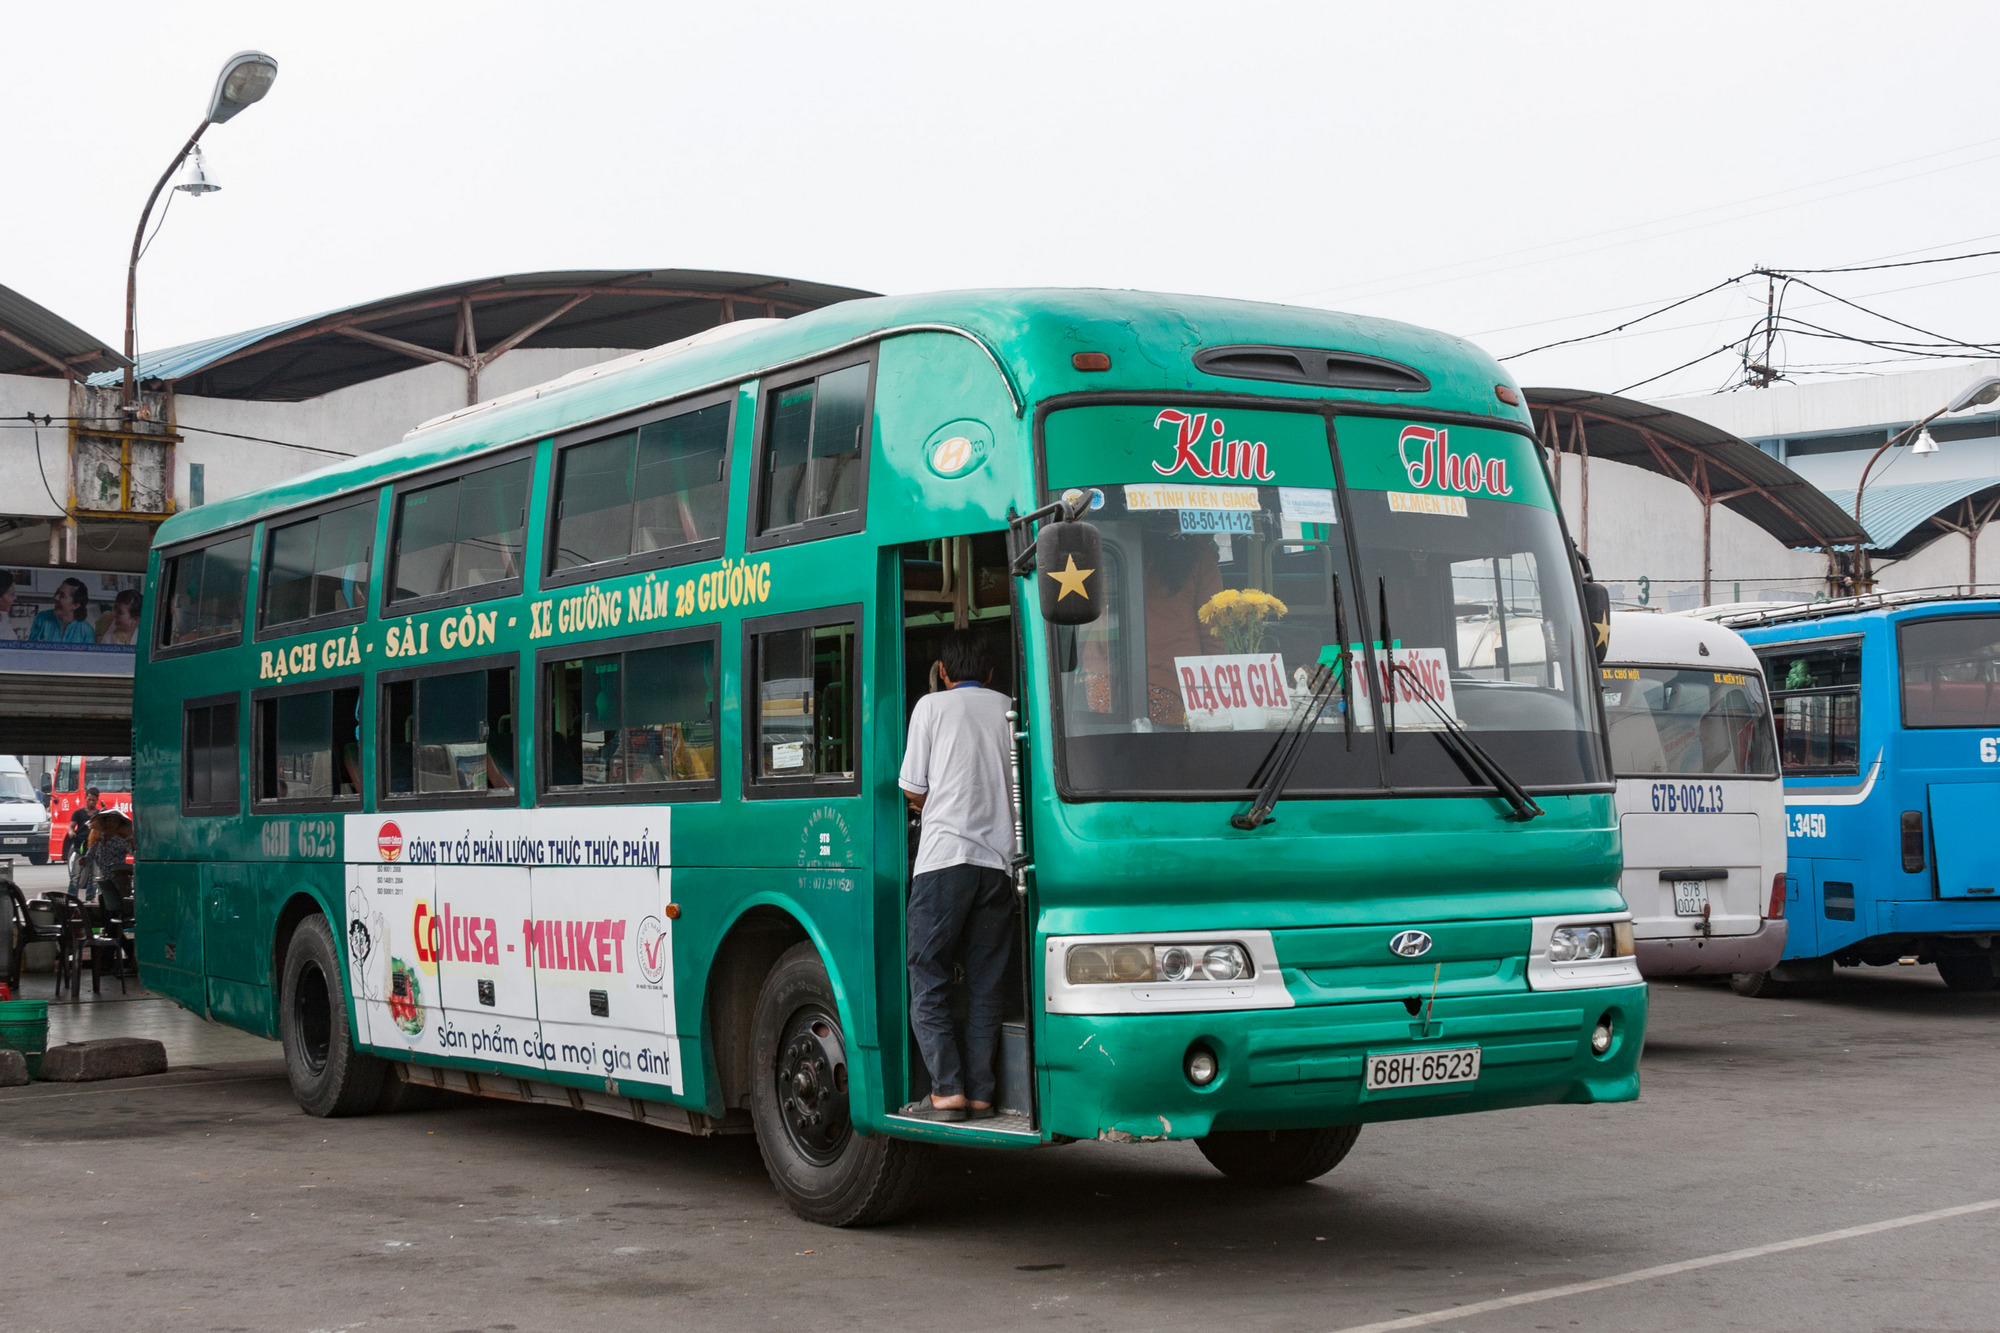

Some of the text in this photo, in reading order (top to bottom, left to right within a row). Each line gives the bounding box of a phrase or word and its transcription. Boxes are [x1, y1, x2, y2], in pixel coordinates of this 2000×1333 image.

[1151, 408, 1276, 481] Kim
[1398, 424, 1514, 497] Thoa
[1188, 487, 1218, 508] KIÊN
[1221, 491, 1258, 508] GIANG
[1181, 511, 1252, 530] 68-50-11-12
[1638, 575, 1650, 605] 3
[260, 642, 317, 683] RẠCH
[322, 627, 361, 669] GIÁ
[386, 617, 429, 657] SÀI
[440, 607, 497, 649] GÒN
[529, 600, 552, 639] XE
[675, 580, 695, 618] 28
[1180, 654, 1288, 716] RẠCH GIÁ
[1399, 650, 1445, 703] CỐNG
[1980, 737, 2000, 763] 6
[1652, 784, 1724, 813] 67B-002.13
[262, 820, 336, 858] 68H 6523
[409, 836, 436, 863] CÔNG
[440, 841, 453, 862] TY
[456, 829, 470, 863] CỔ
[473, 830, 503, 863] PHẦN
[623, 827, 660, 865] PHẨM
[1682, 881, 1700, 897] 67B
[414, 903, 499, 965] Colusa
[523, 919, 626, 973] MILIKET
[437, 1021, 467, 1049] Sản
[471, 1024, 519, 1055] phẩm
[523, 1033, 557, 1061] của
[562, 1042, 597, 1070] mọi
[602, 1045, 631, 1073] gia
[1373, 1052, 1474, 1086] 68H-6523
